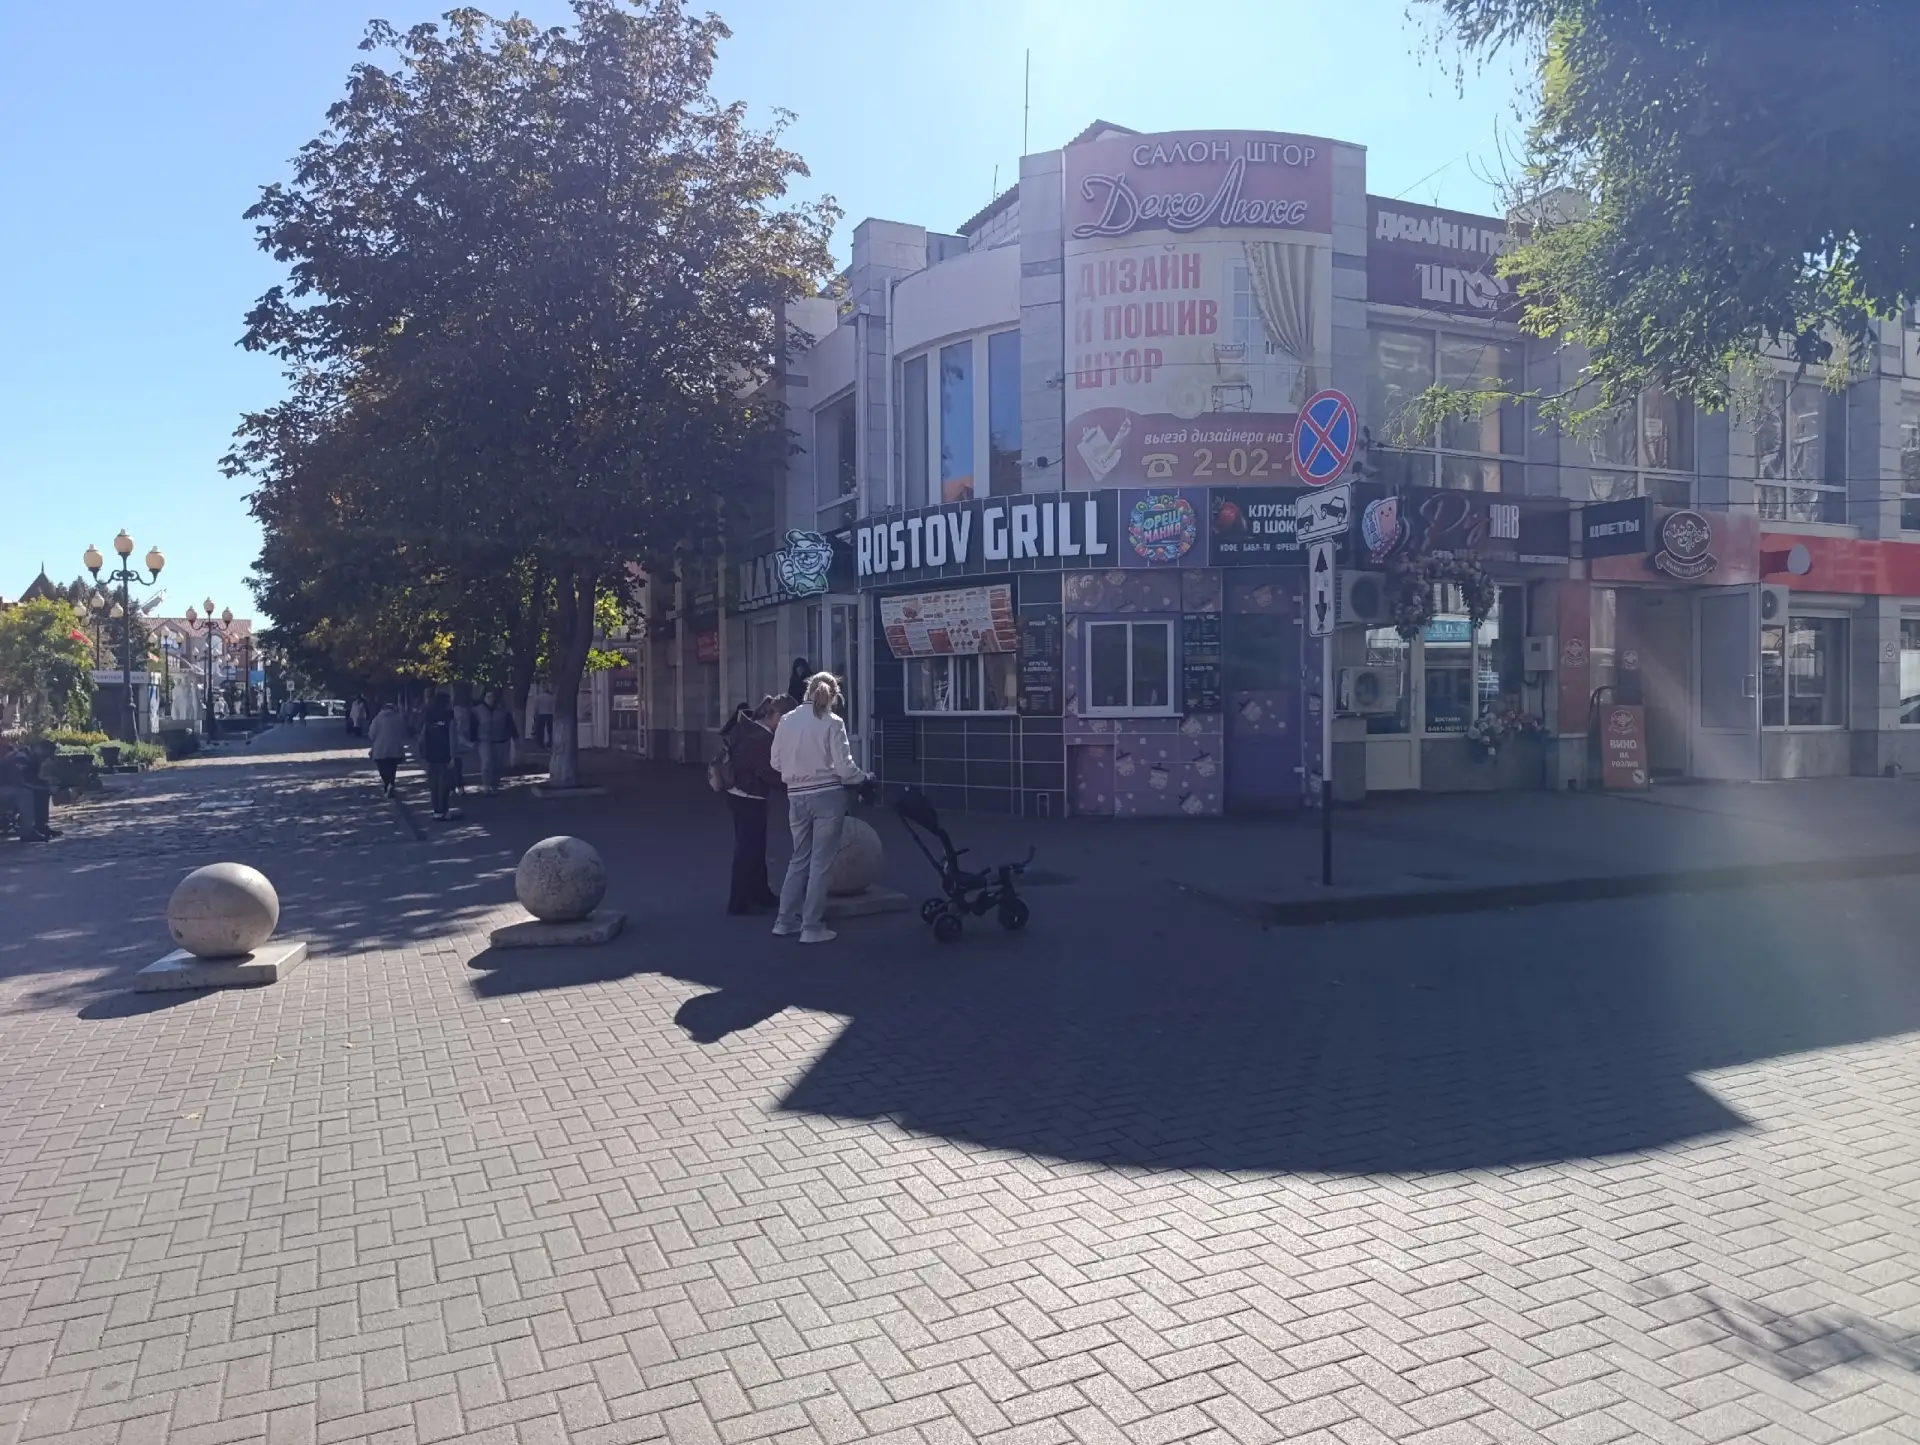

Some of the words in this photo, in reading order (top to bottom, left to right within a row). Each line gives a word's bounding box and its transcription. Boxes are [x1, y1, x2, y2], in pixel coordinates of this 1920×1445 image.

[1132, 141, 1230, 166] САЛОН
[1246, 140, 1316, 167] ШТОР
[1376, 210, 1459, 250] ДИЗАЙН
[1462, 225, 1477, 252] И
[1075, 245, 1201, 303] ДИЗАЙН
[1075, 308, 1093, 344] И
[1103, 299, 1218, 341] ПОШИВ
[1075, 348, 1163, 389] ШТОР
[1144, 429, 1187, 445] выезд
[1190, 428, 1263, 445] дизайнера
[1267, 430, 1284, 443] на
[1143, 510, 1181, 530] ФРЕШ
[1252, 520, 1261, 533] В
[1589, 519, 1640, 539] ЦВЕТЫ
[857, 510, 971, 576] ROSTOV
[983, 500, 1107, 560] GRILL
[1143, 522, 1181, 543] МАНИЯ
[1610, 739, 1637, 749] ВИНО
